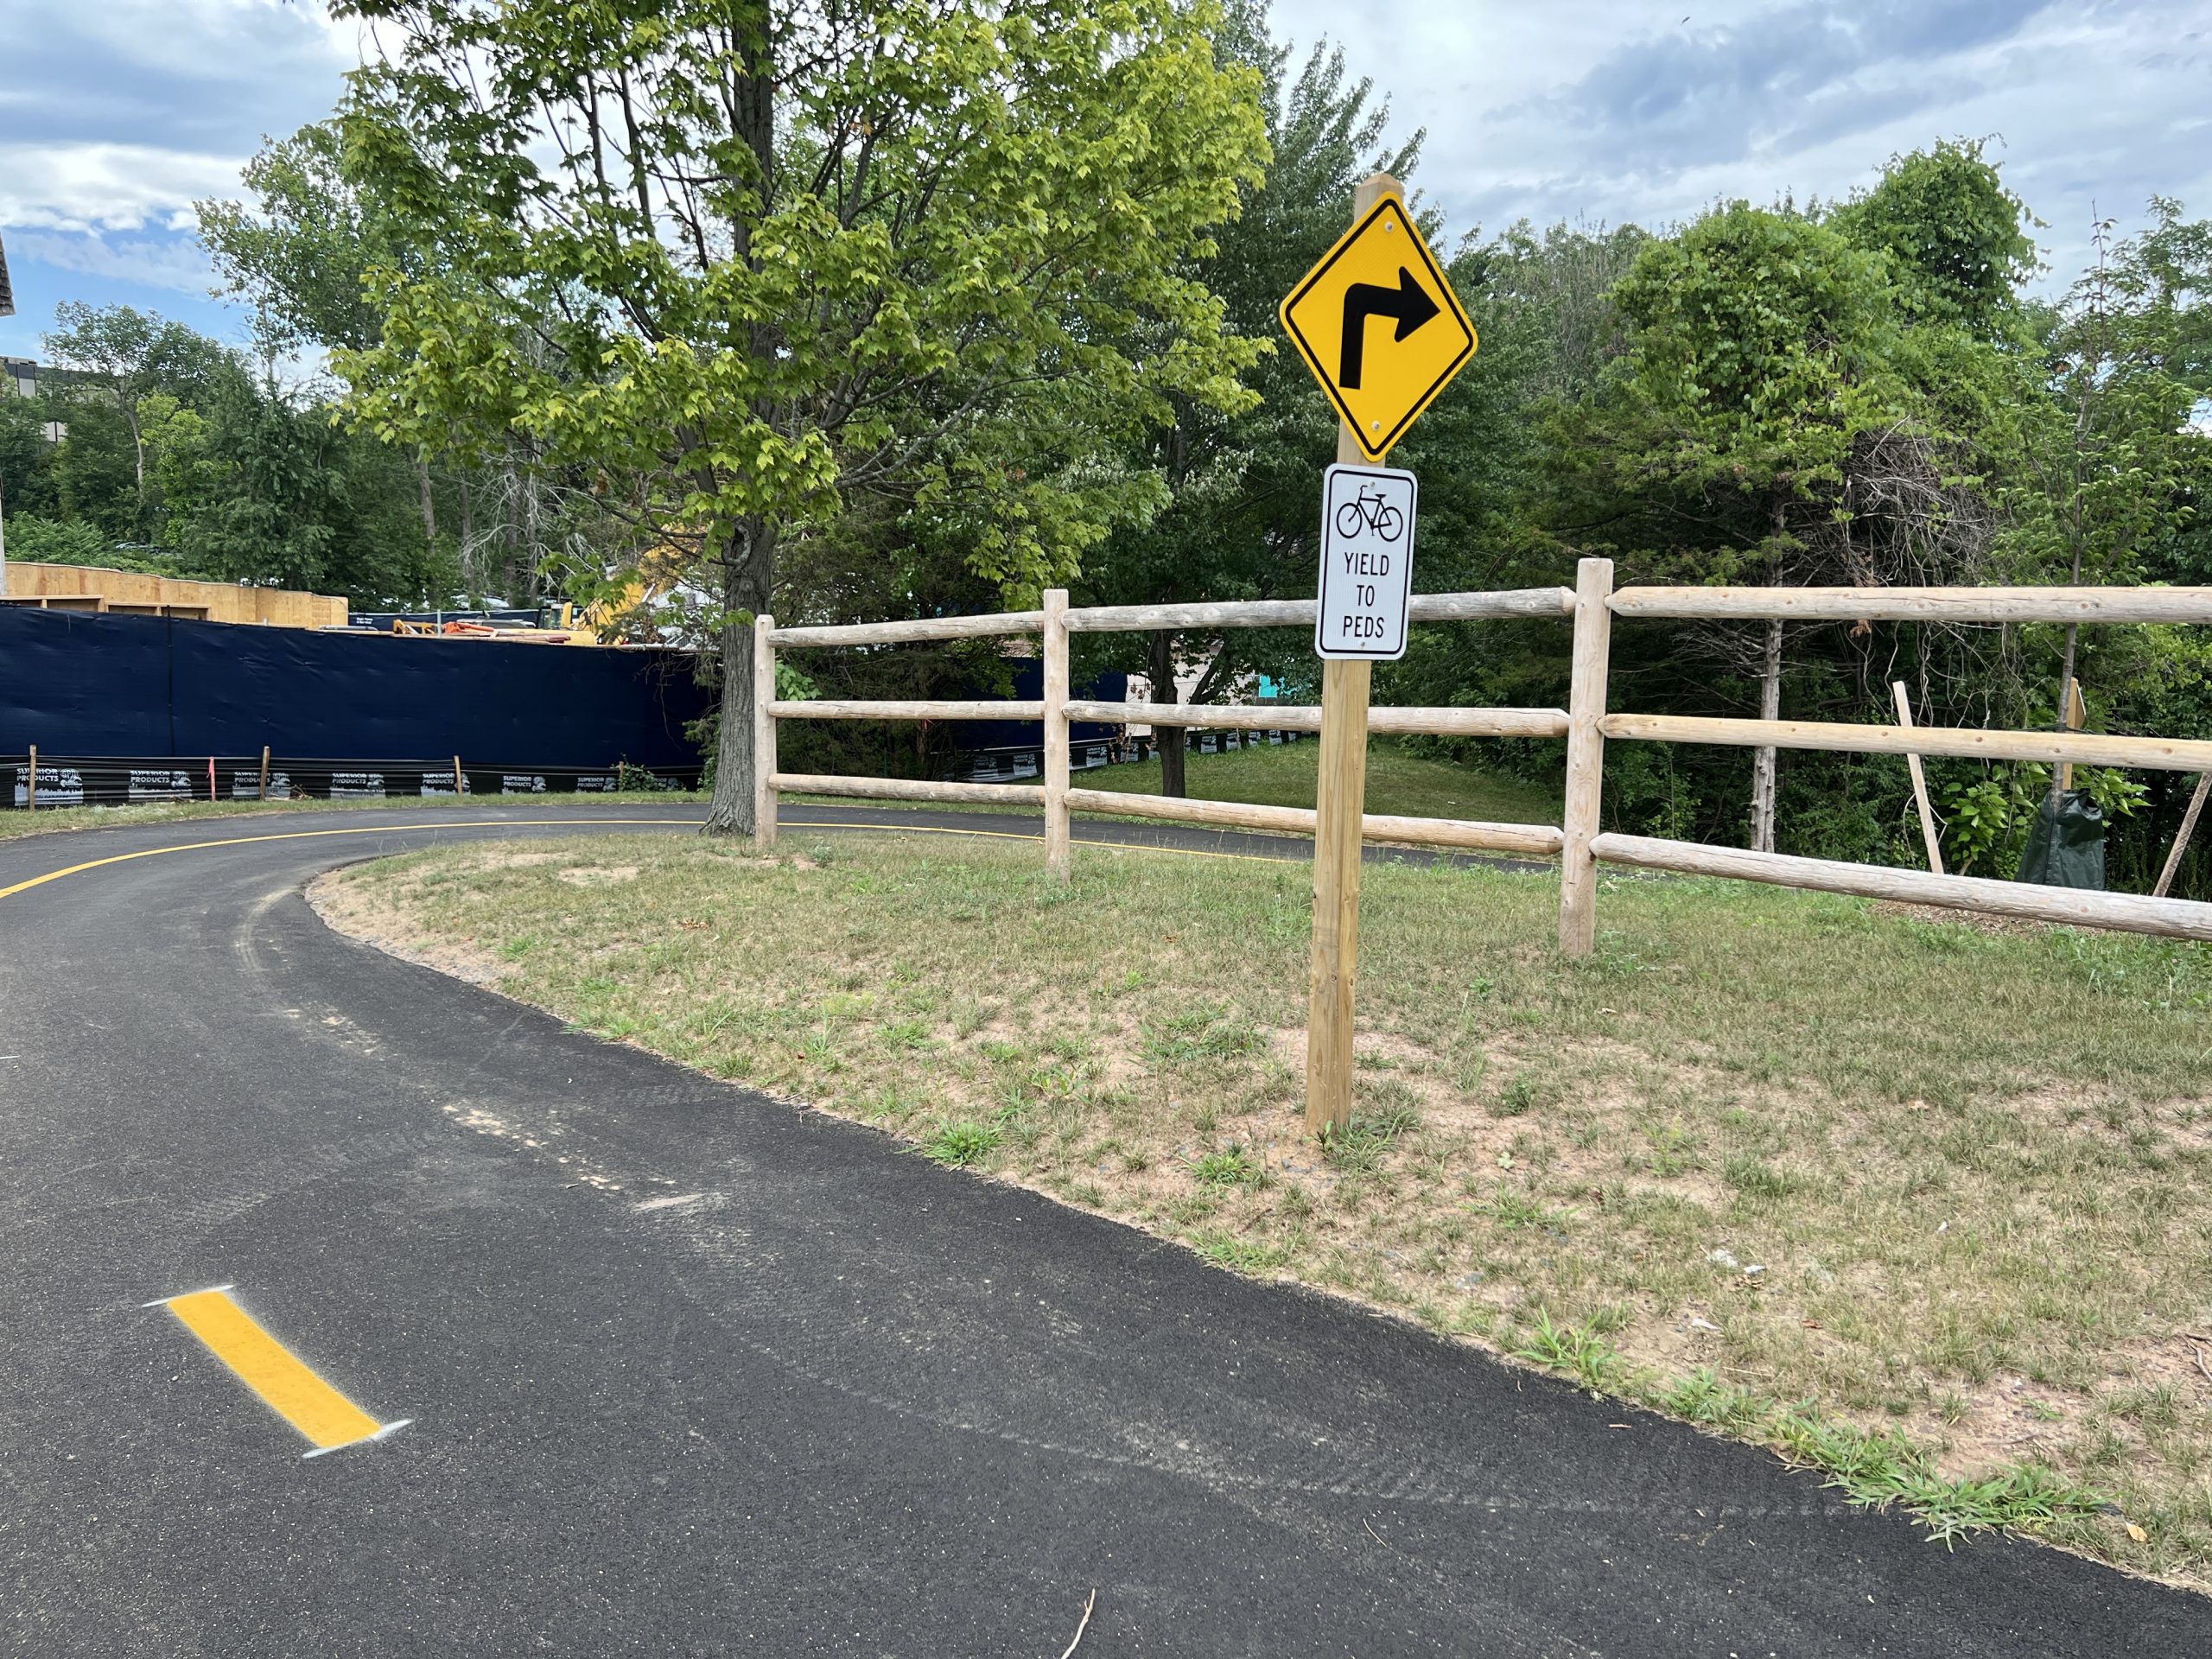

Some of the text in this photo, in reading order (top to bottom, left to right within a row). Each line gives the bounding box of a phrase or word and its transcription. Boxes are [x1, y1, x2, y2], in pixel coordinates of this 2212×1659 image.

[1344, 551, 1389, 576] YIELD
[1356, 584, 1375, 607] TO
[1343, 615, 1385, 639] PEDS
